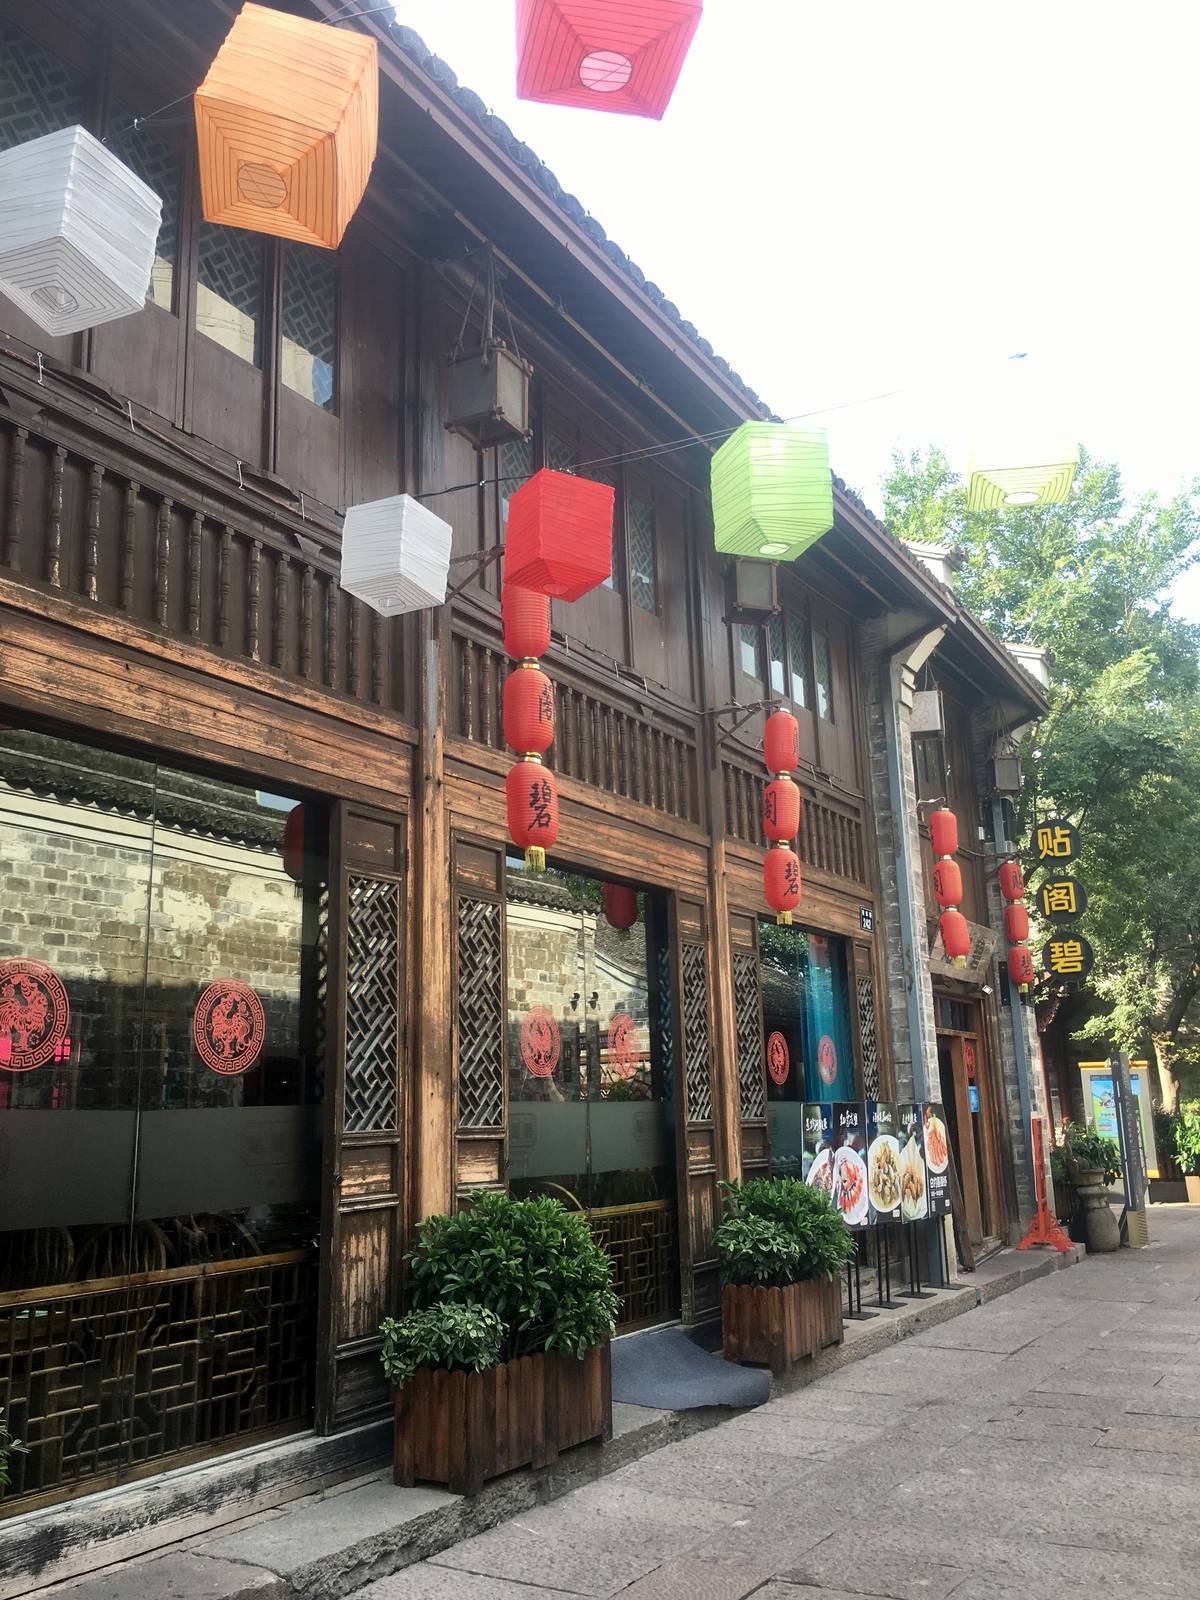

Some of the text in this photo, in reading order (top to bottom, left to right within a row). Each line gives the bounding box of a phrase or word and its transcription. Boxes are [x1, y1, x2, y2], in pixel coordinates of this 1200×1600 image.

[528, 779, 551, 831] 碧
[784, 859, 799, 896] 碧
[1037, 825, 1084, 974] 贴阁碧
